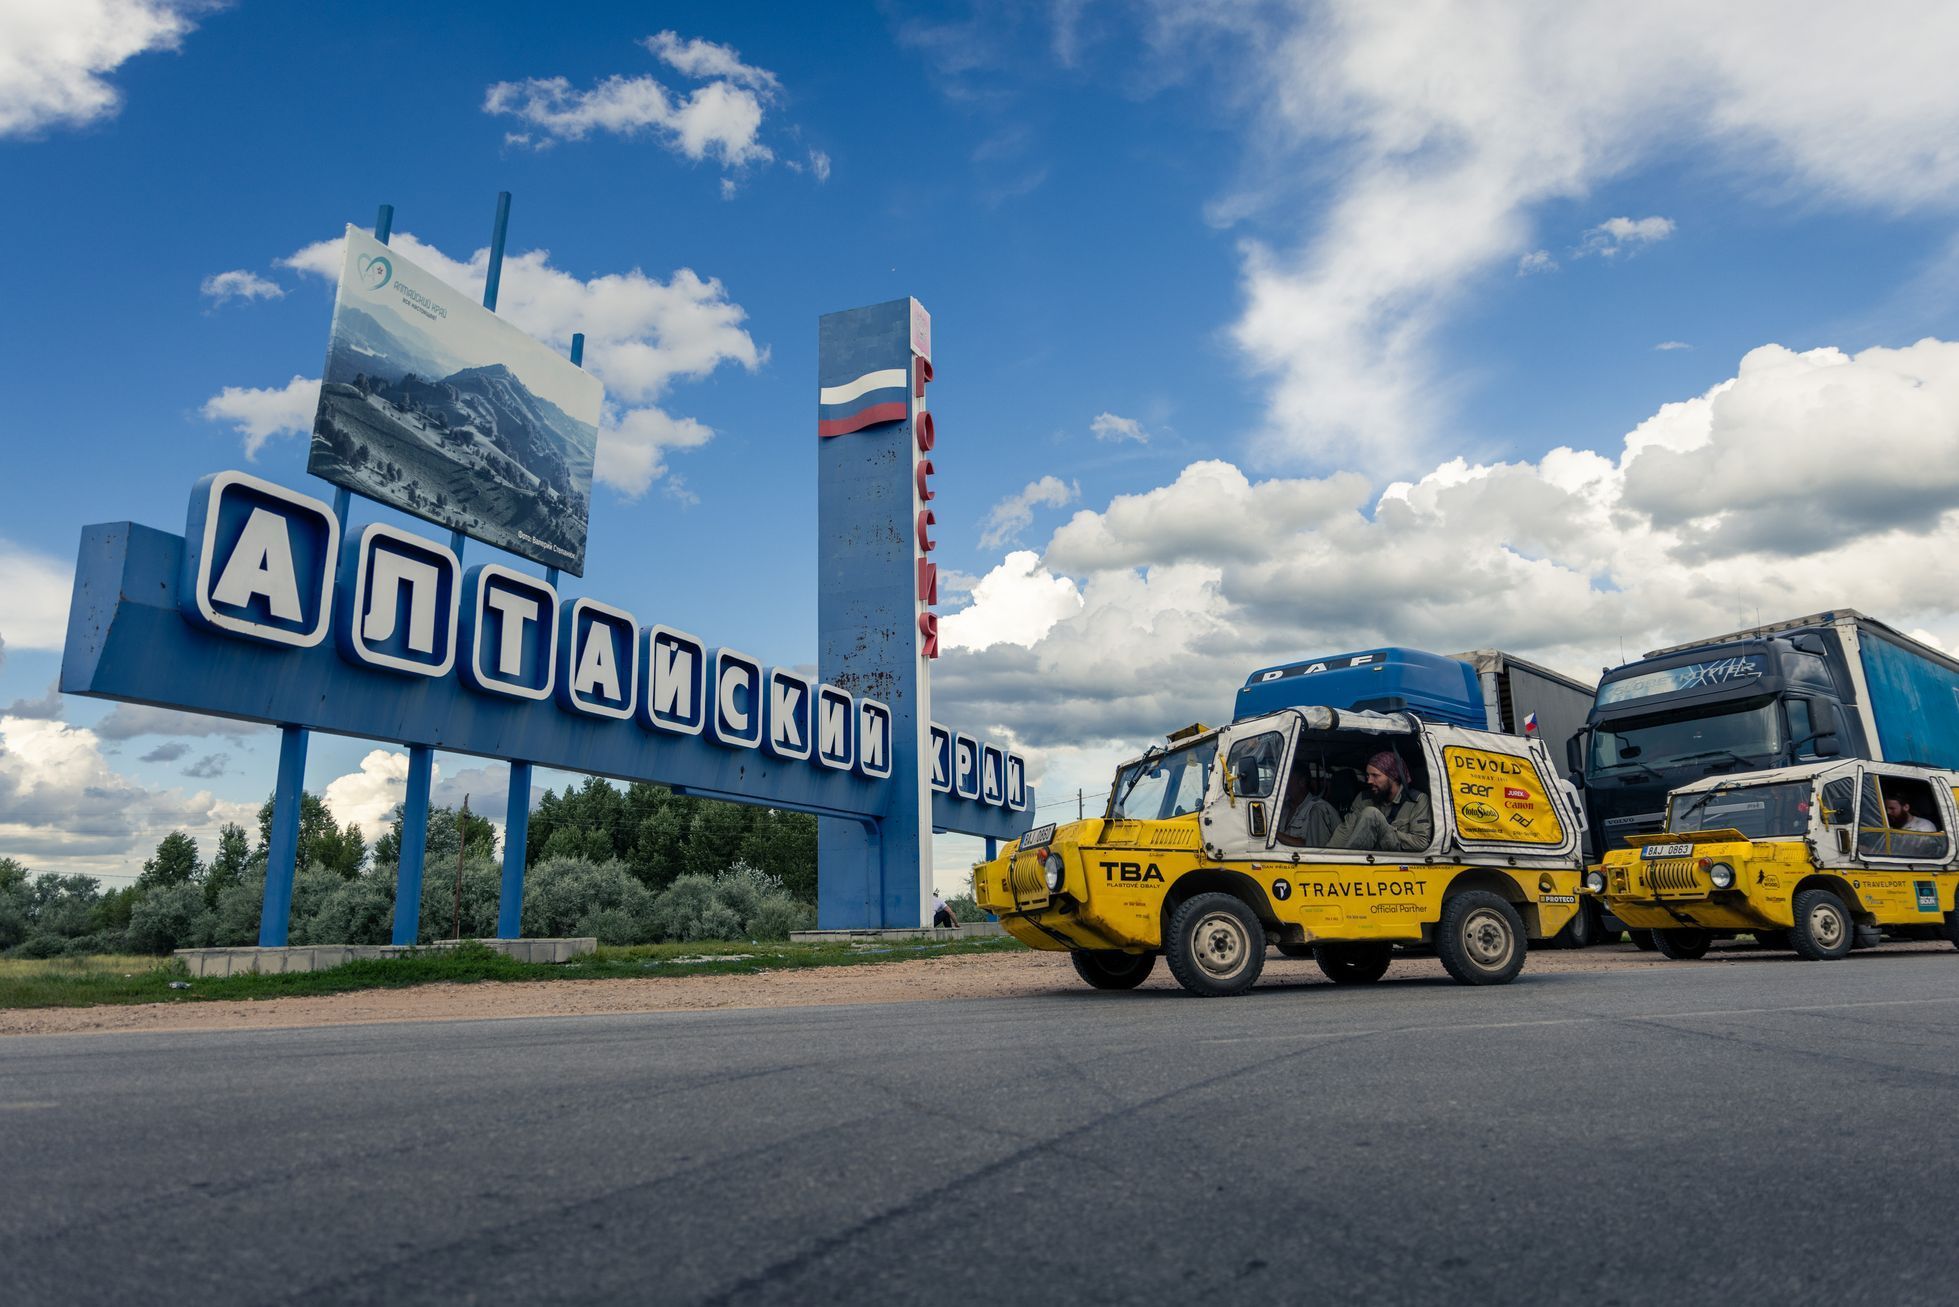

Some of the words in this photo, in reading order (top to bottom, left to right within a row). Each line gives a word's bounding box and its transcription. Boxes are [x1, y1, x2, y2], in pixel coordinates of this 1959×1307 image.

[915, 355, 939, 659] РОССИЯ
[212, 507, 883, 767] АЛТАЙСКИЙ
[930, 734, 1021, 802] КРАЙ
[1261, 654, 1373, 682] DAF
[1454, 755, 1522, 775] DEVOLD
[1460, 782, 1494, 797] acer
[1504, 801, 1534, 810] Canon
[1607, 817, 1635, 825] VOLVO
[1648, 846, 1663, 856] 8AJ
[1667, 845, 1689, 855] 0863
[1099, 862, 1165, 882] TBA
[1298, 881, 1428, 897] TRAVELPORT
[1862, 880, 1906, 889] TRAVELPORT
[1370, 904, 1398, 914] Official
[1399, 904, 1428, 913] Partner
